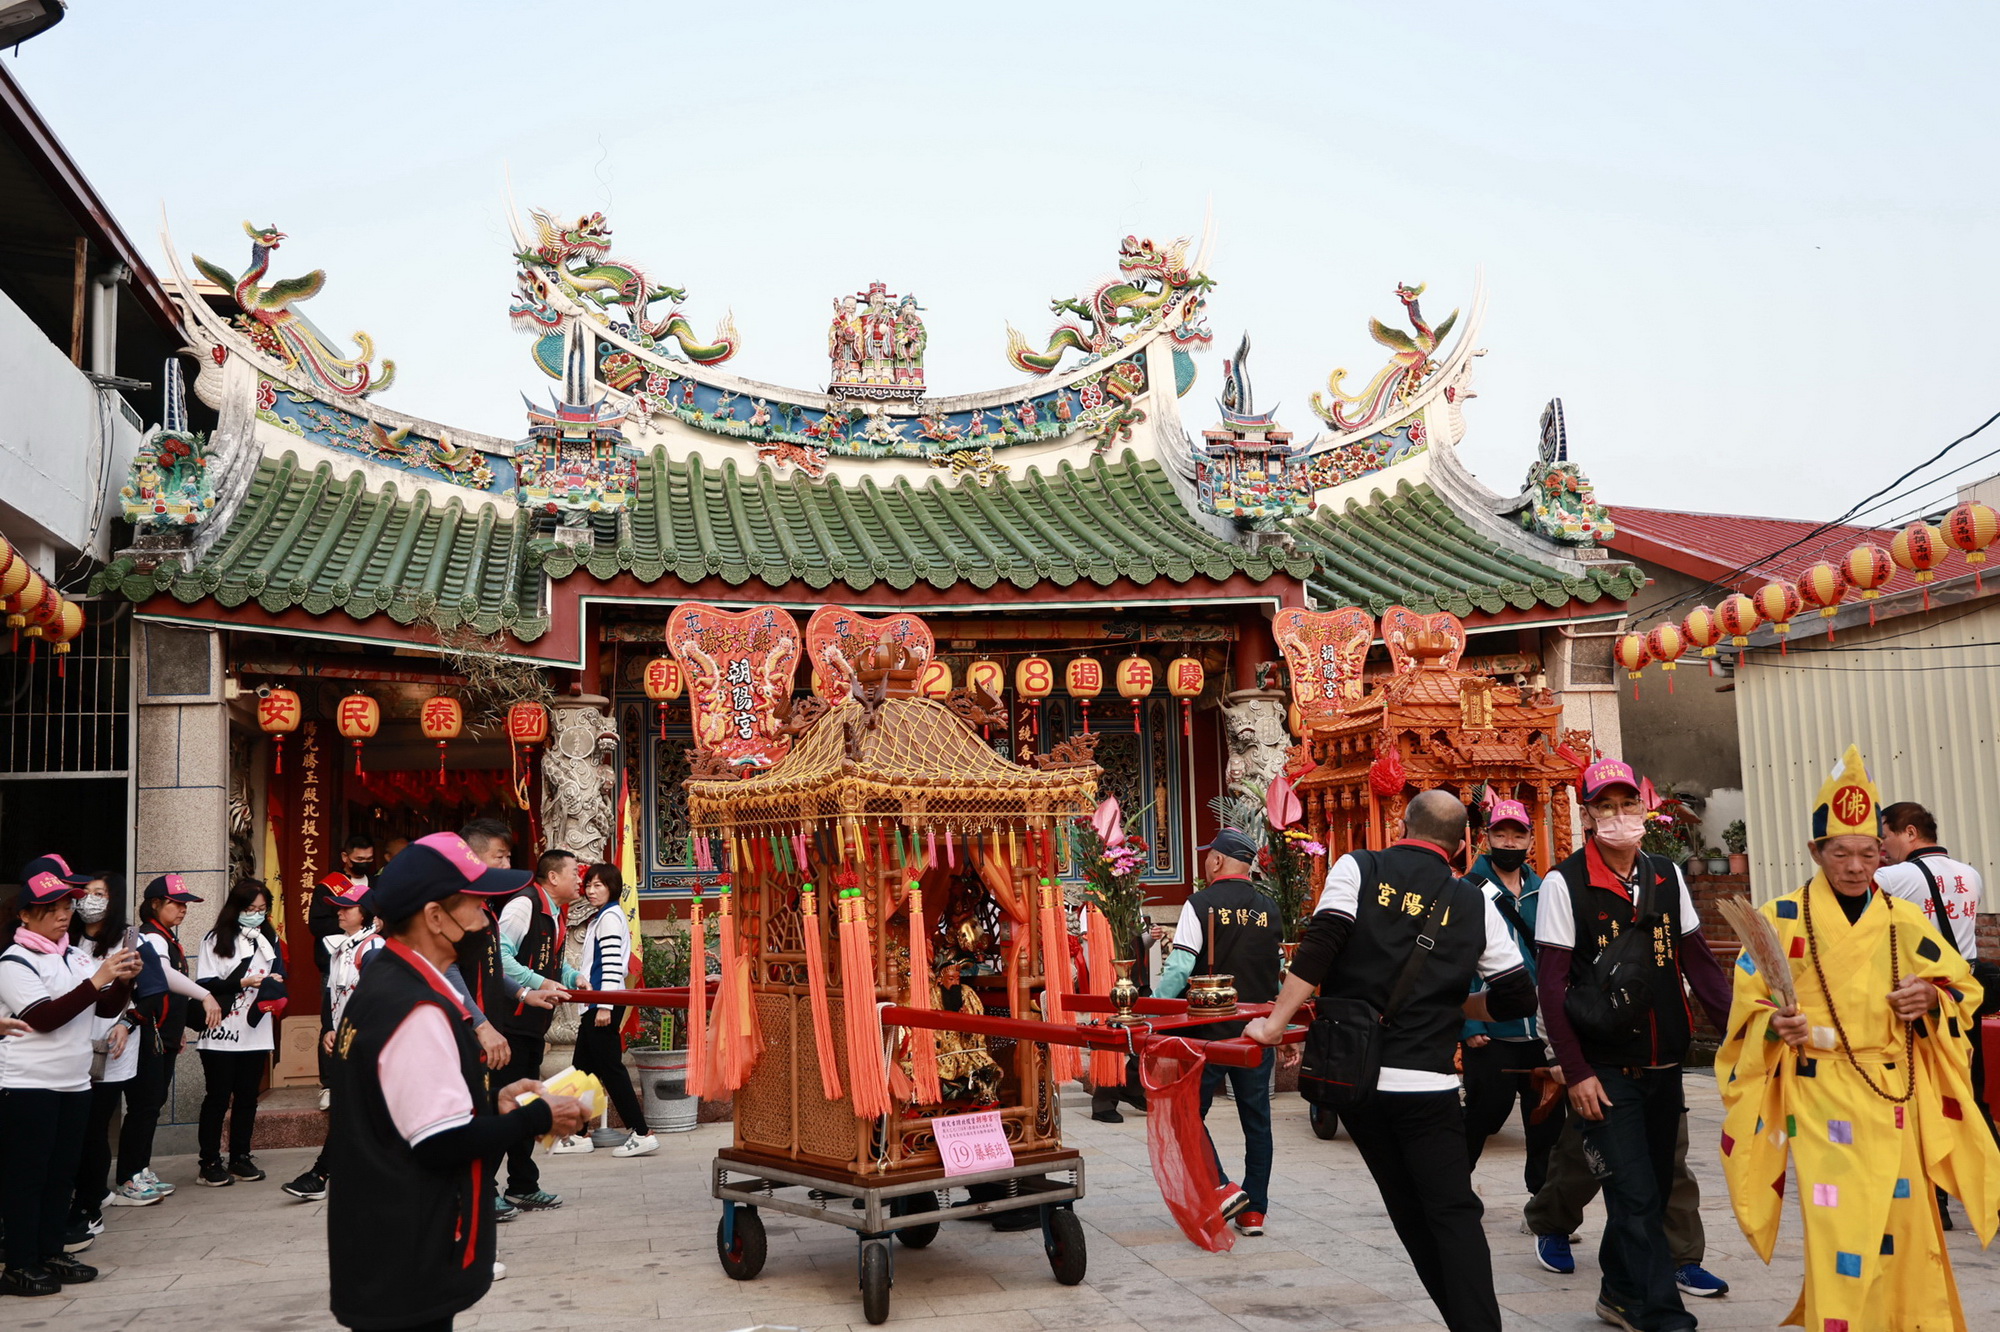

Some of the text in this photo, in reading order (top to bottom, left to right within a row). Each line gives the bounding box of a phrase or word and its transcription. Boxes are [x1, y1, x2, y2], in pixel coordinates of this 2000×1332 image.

[684, 612, 702, 634] 屯
[834, 617, 850, 638] 屯
[648, 662, 680, 692] 朝
[923, 664, 946, 696] 2
[1024, 660, 1049, 692] 8
[1072, 663, 1100, 691] 週
[1126, 662, 1152, 690] 年
[1177, 663, 1203, 691] 慶
[1321, 645, 1338, 700] 朝陽宮
[259, 695, 543, 737] 國 泰 民 安
[726, 658, 757, 740] 朝陽宮
[1017, 697, 1035, 769] 夕繞香
[1837, 789, 1867, 823] 佛
[1378, 883, 1450, 927] 陽宮
[1653, 926, 1666, 967] 朝陽宮
[953, 1145, 970, 1163] 19
